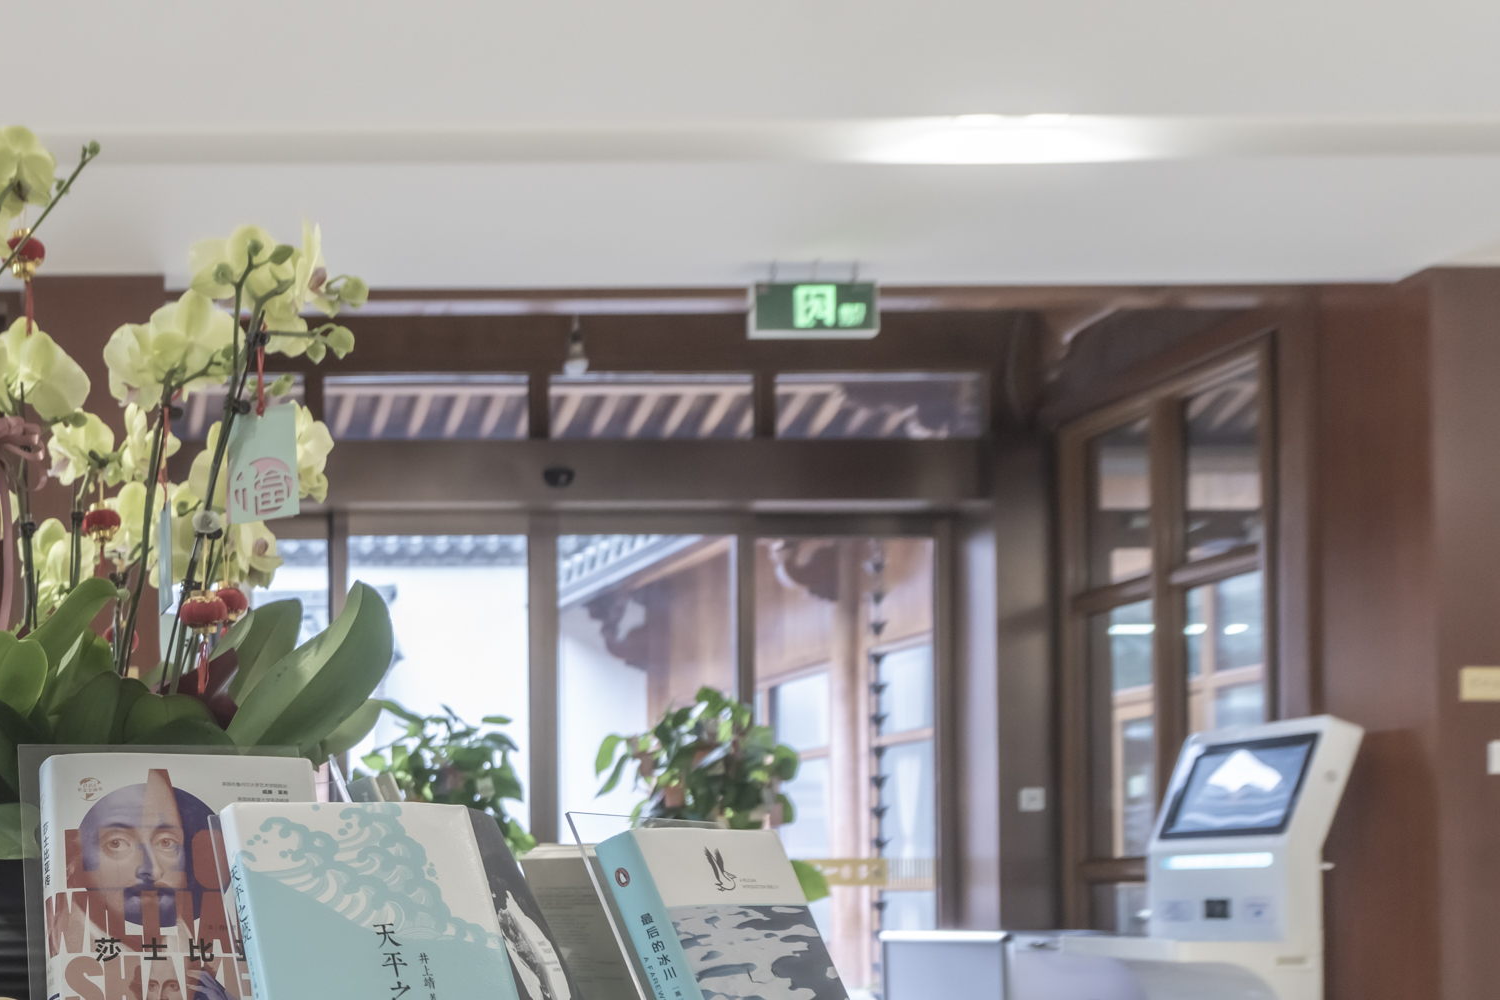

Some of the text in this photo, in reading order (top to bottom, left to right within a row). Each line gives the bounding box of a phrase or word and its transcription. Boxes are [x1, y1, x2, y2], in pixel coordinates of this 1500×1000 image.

[419, 952, 436, 989] 井上靖
[640, 912, 678, 981] 最后的冰川
